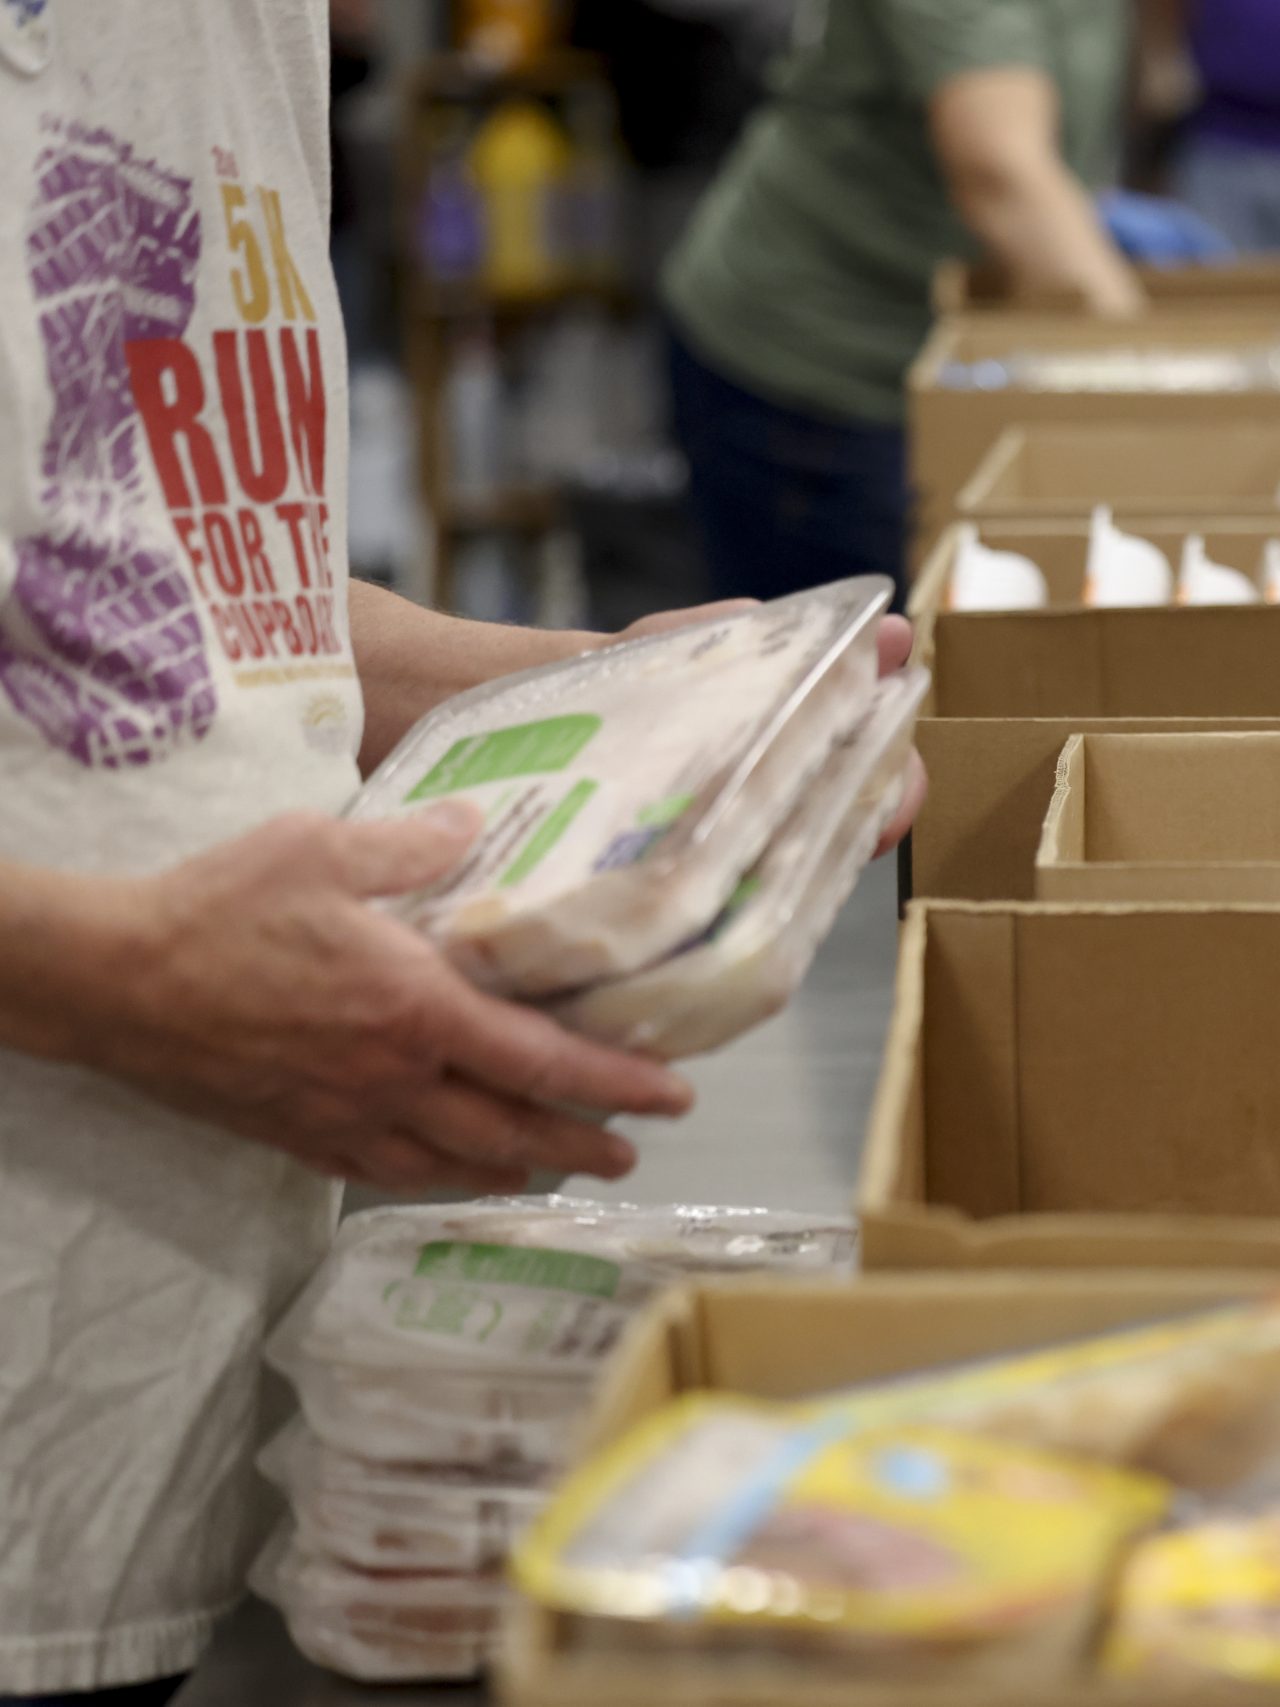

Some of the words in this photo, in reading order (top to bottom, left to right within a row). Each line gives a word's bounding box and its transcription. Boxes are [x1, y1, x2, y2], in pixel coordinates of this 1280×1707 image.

[219, 183, 318, 324] 5K
[124, 328, 327, 510] RUN
[173, 508, 277, 600] FOR
